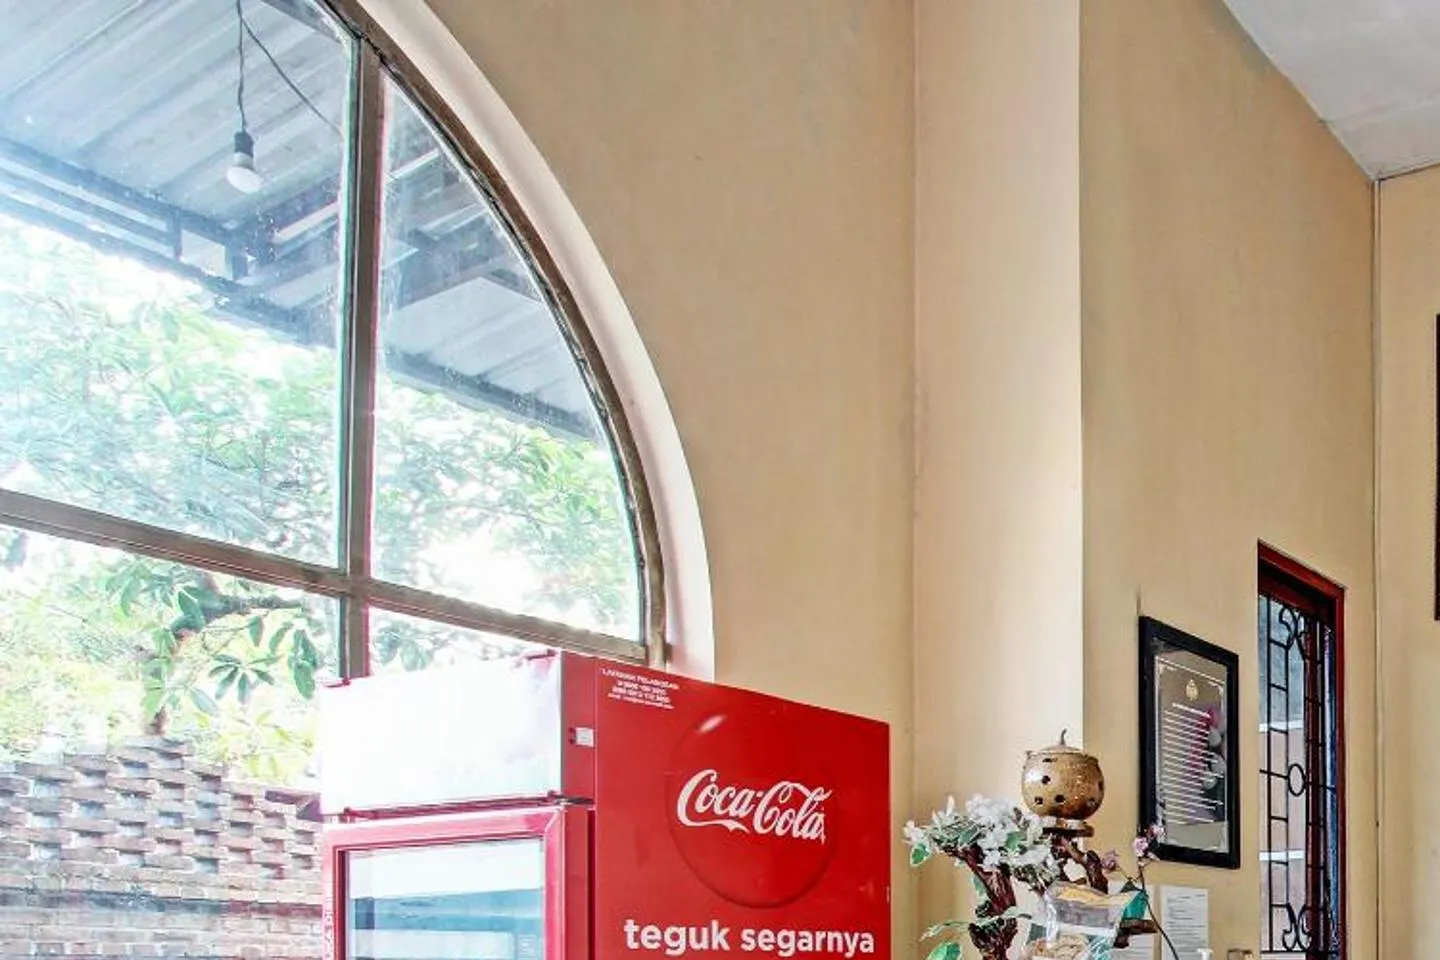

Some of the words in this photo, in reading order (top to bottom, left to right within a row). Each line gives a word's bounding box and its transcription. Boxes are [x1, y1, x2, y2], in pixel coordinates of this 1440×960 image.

[676, 769, 833, 845] Coca-Cola
[623, 918, 731, 957] teguk
[740, 926, 875, 959] segarnya
